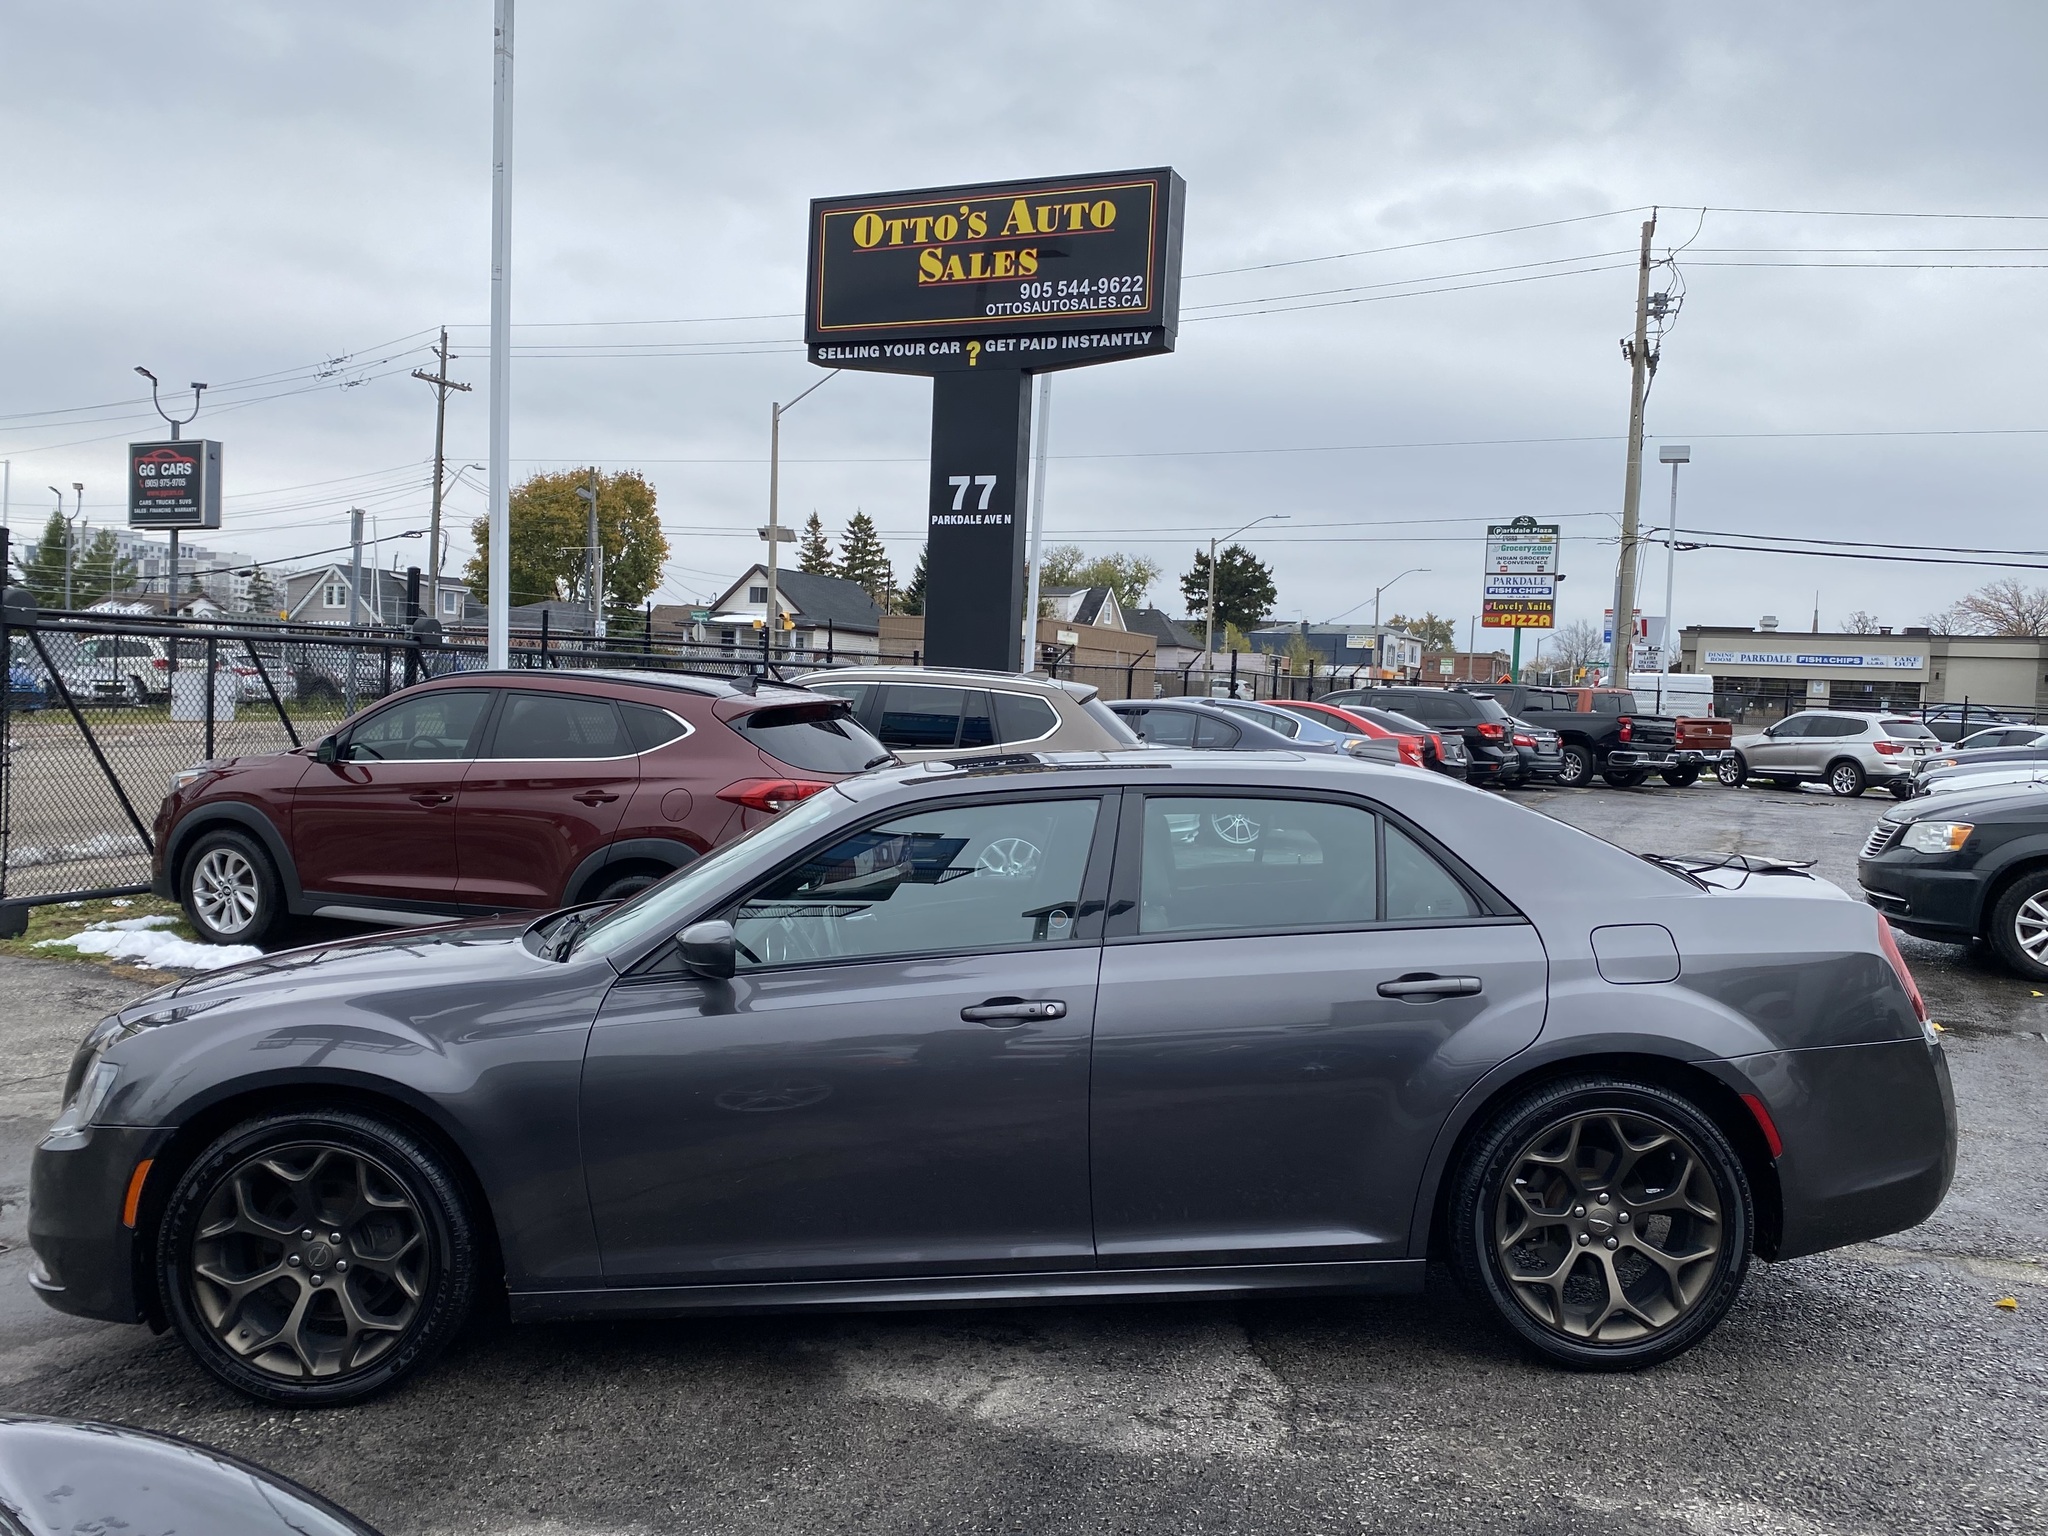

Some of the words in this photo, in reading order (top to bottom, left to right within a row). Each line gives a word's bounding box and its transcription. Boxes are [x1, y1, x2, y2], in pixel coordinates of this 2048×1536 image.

[852, 205, 987, 249] OTTO'S
[1001, 199, 1117, 236] AUTO
[918, 247, 1039, 284] SALES
[1020, 282, 1052, 300] 905
[1057, 275, 1143, 297] 544-9622
[985, 294, 1142, 315] OTTOSAUTOSALES.CA
[818, 346, 880, 360] SELLING
[883, 343, 926, 358] YOUR
[929, 342, 961, 355] CAR
[965, 340, 981, 366] ?
[985, 339, 1016, 353] GET
[1020, 337, 1058, 351] PAID
[1061, 331, 1152, 349] INSTANTLY
[139, 464, 155, 476] GG
[161, 462, 192, 476] CARS
[144, 479, 158, 488] (905)
[948, 475, 997, 510] 77
[931, 515, 982, 525] PARKDALE
[984, 514, 1002, 524] AVE
[1004, 514, 1012, 524] N
[1501, 545, 1552, 553] Groceryzone
[1493, 577, 1547, 585] PARKDALE
[1493, 602, 1523, 612] Lovely
[1527, 602, 1552, 610] Nails
[1500, 613, 1550, 626] PIZZA
[1740, 654, 1792, 663] PARKDALE
